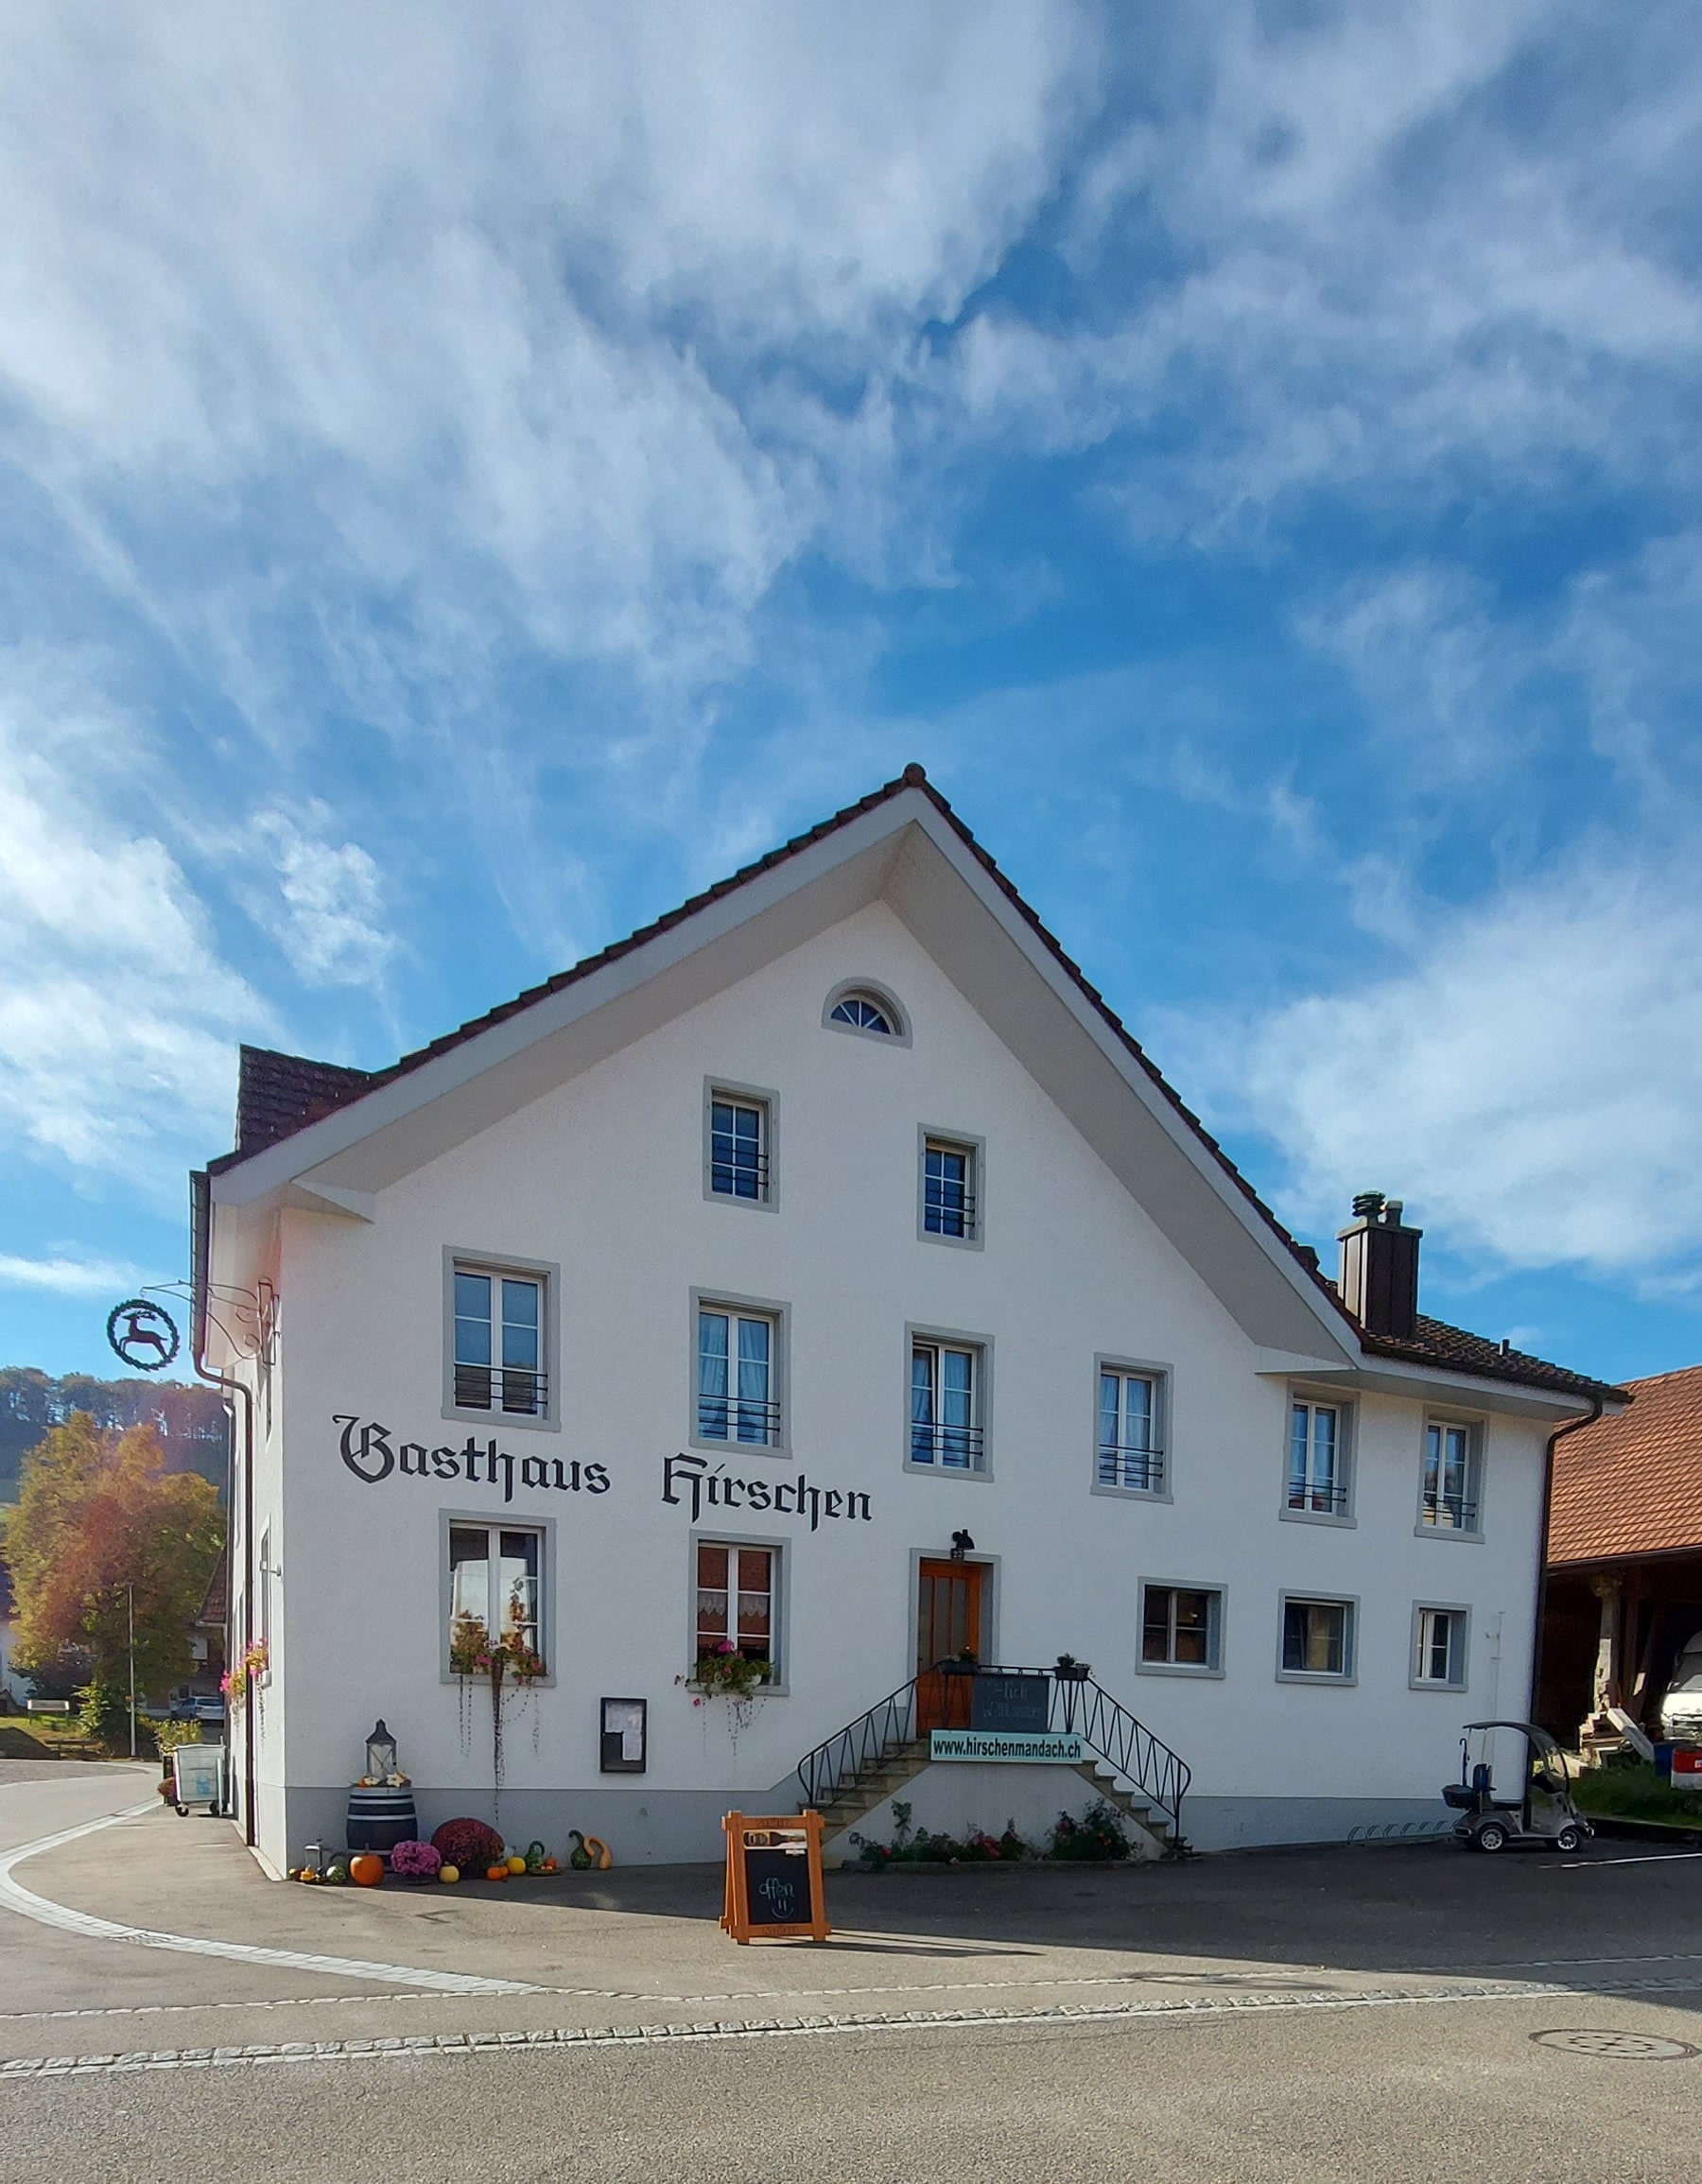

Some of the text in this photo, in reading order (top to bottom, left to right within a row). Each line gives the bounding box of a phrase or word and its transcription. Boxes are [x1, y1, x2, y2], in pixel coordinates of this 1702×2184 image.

[332, 1414, 873, 1533] Gasthaus Hirschen
[933, 1736, 1082, 1759] www.hirschenmandach.ch
[758, 1877, 795, 1900] offen
